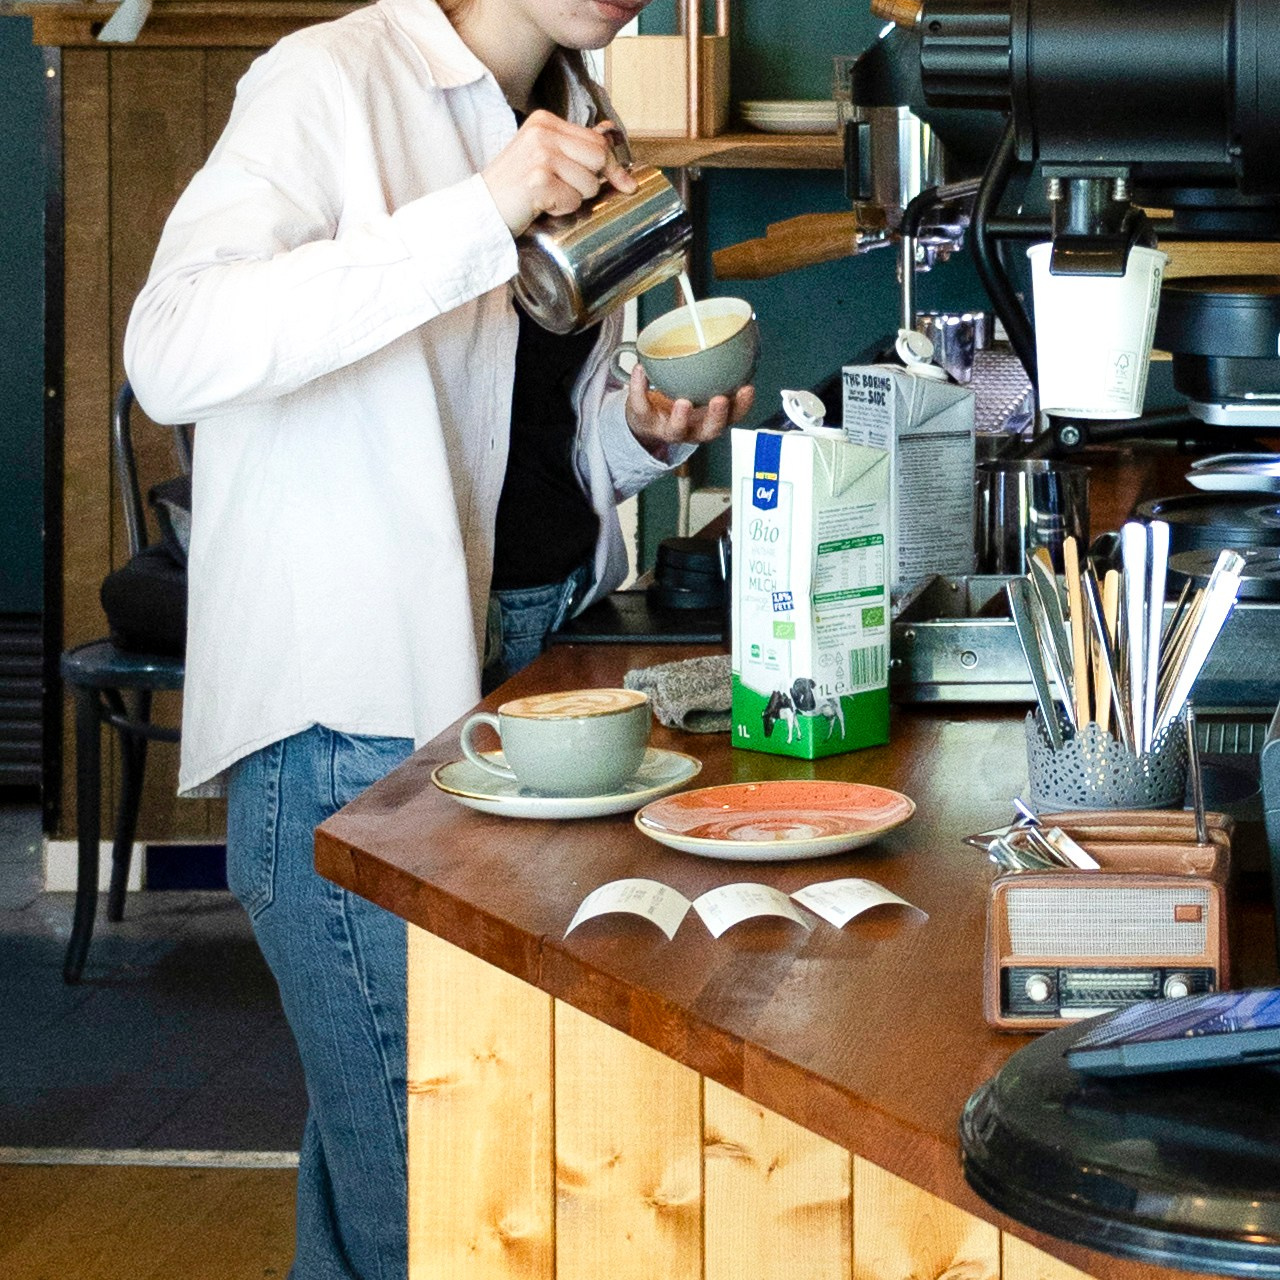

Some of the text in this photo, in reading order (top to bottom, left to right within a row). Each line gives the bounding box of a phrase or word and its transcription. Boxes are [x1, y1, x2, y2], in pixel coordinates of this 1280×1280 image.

[843, 372, 891, 392] THE BORING
[868, 390, 886, 406] SIDE
[756, 486, 775, 503] Chef
[749, 518, 779, 543] Bio
[749, 560, 777, 576] VOLL-
[749, 577, 777, 592] MILCH
[737, 724, 750, 738] 1L
